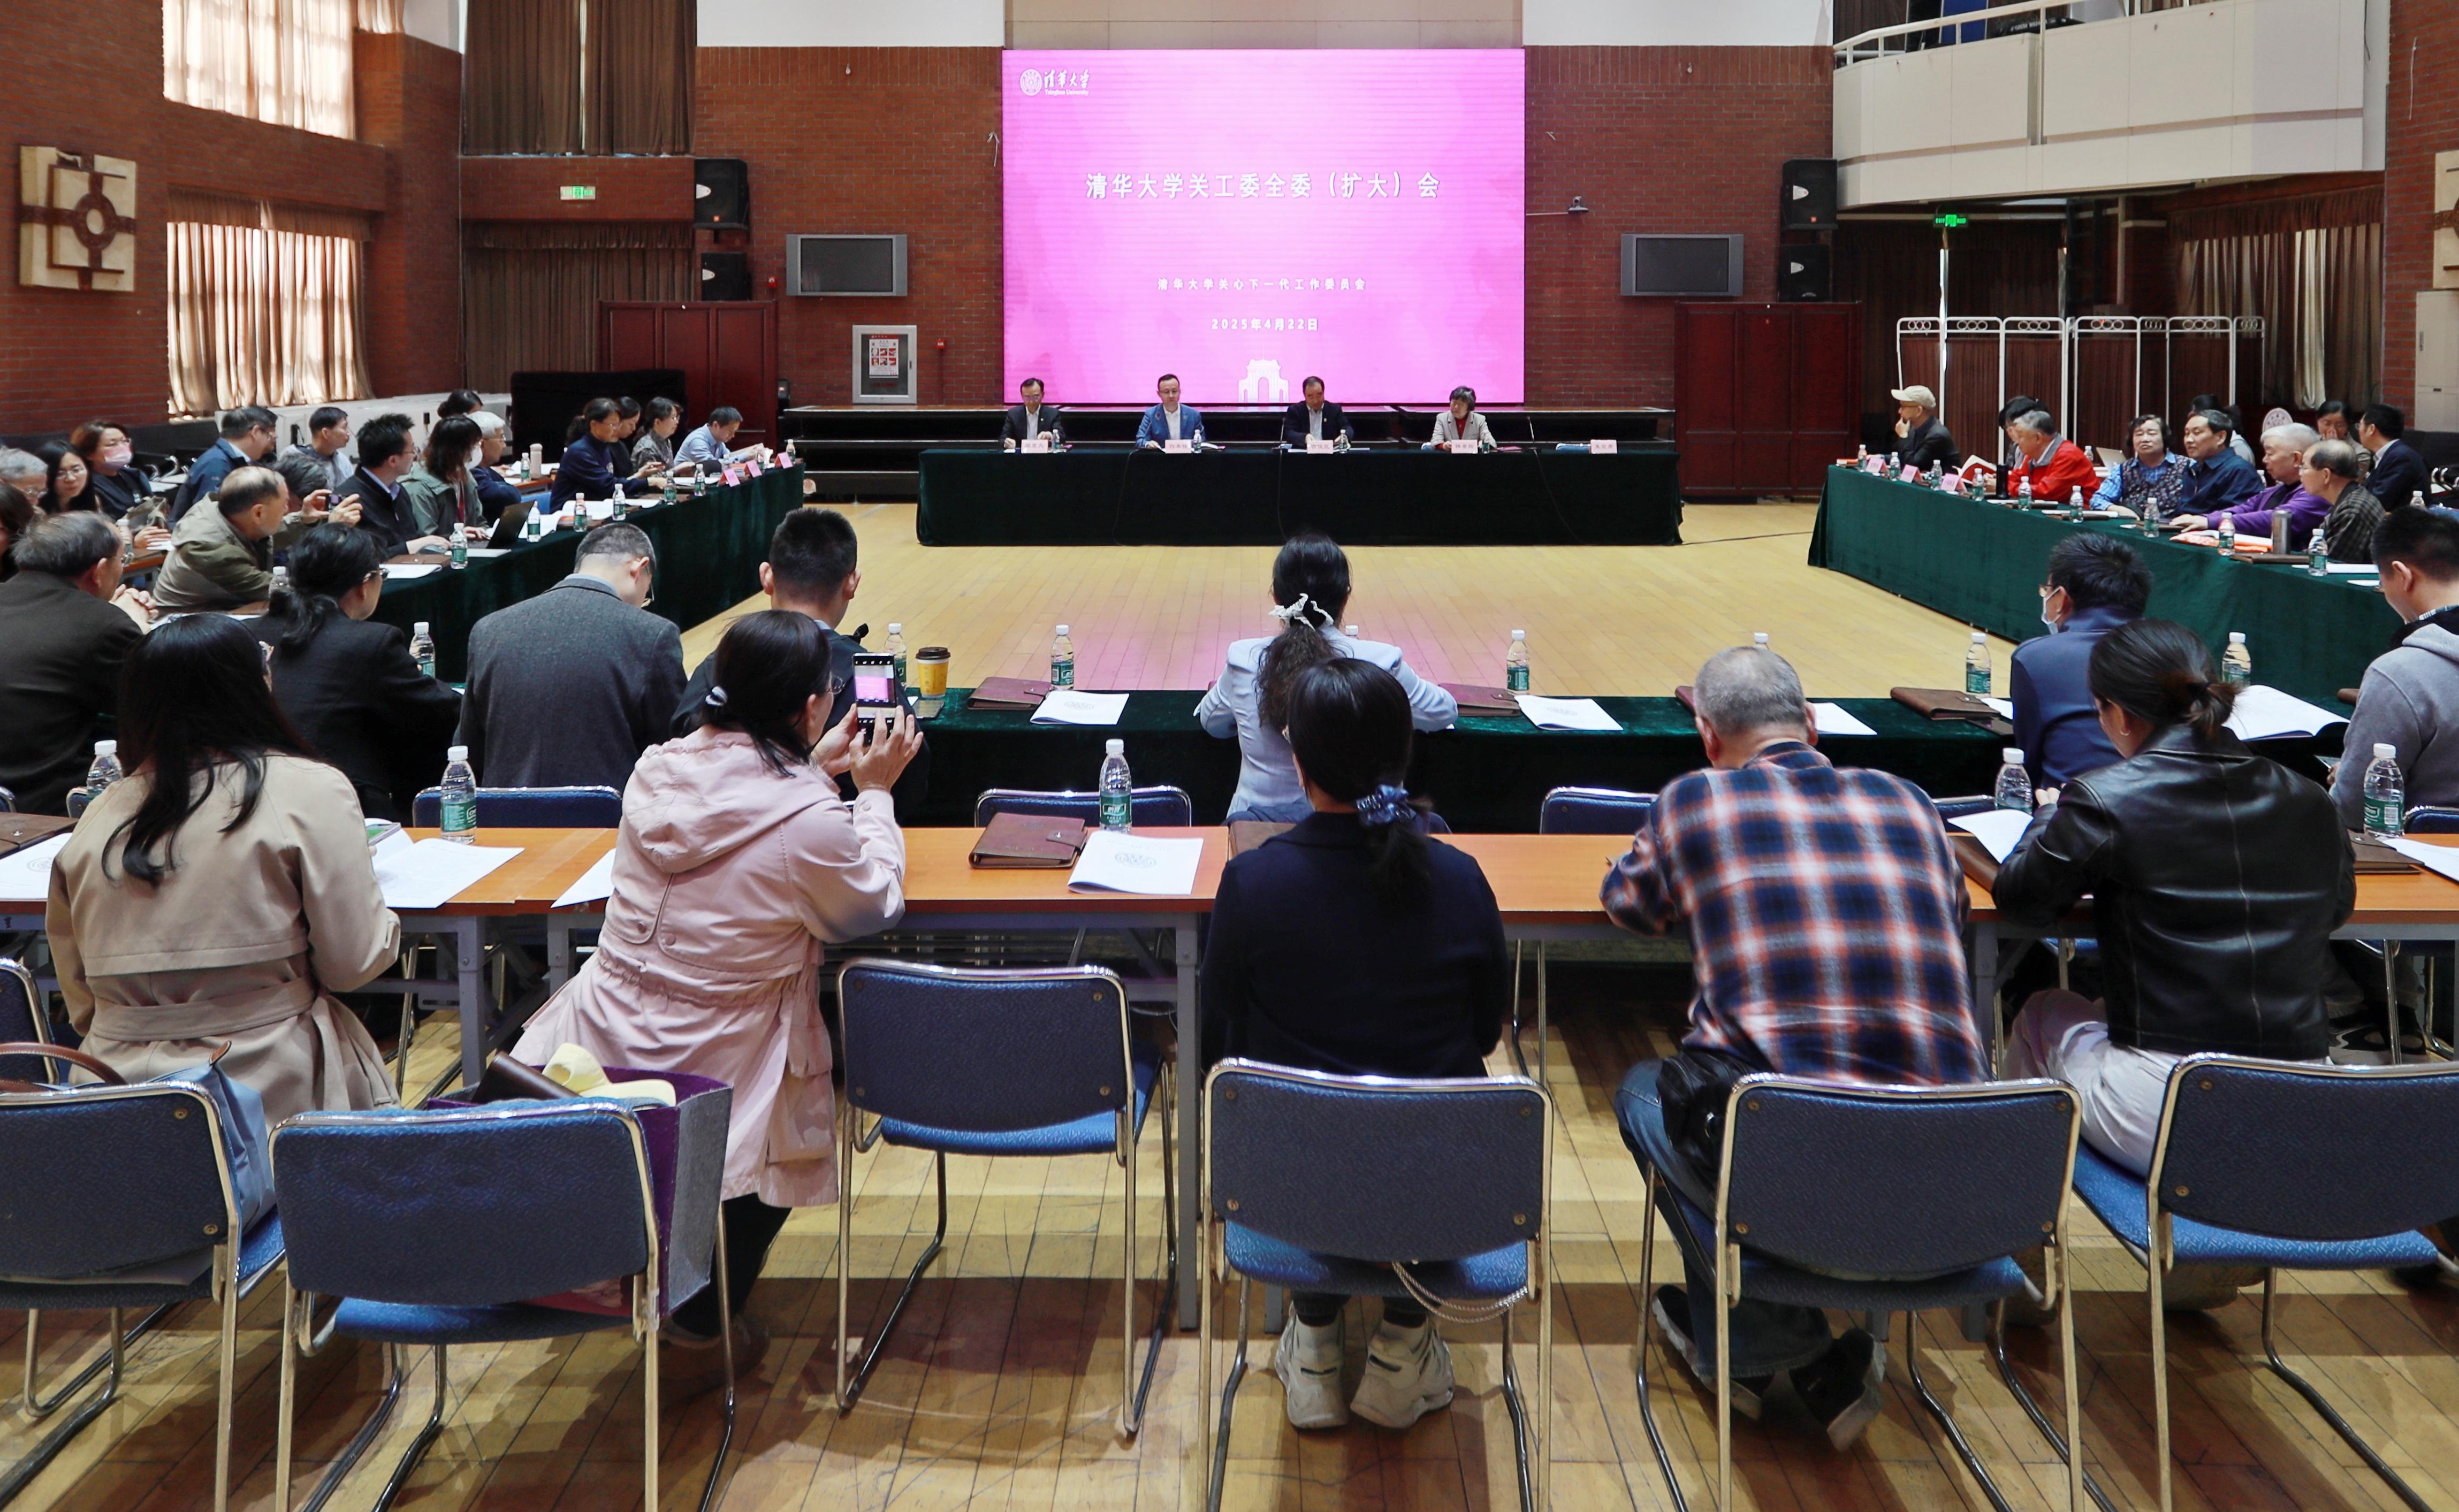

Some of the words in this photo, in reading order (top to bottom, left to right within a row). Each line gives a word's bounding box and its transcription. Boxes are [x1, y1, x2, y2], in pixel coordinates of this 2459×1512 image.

[1158, 277, 1366, 291] 清华大学关心下一代工作委员会
[1211, 317, 1318, 332] 2025年4月22日
